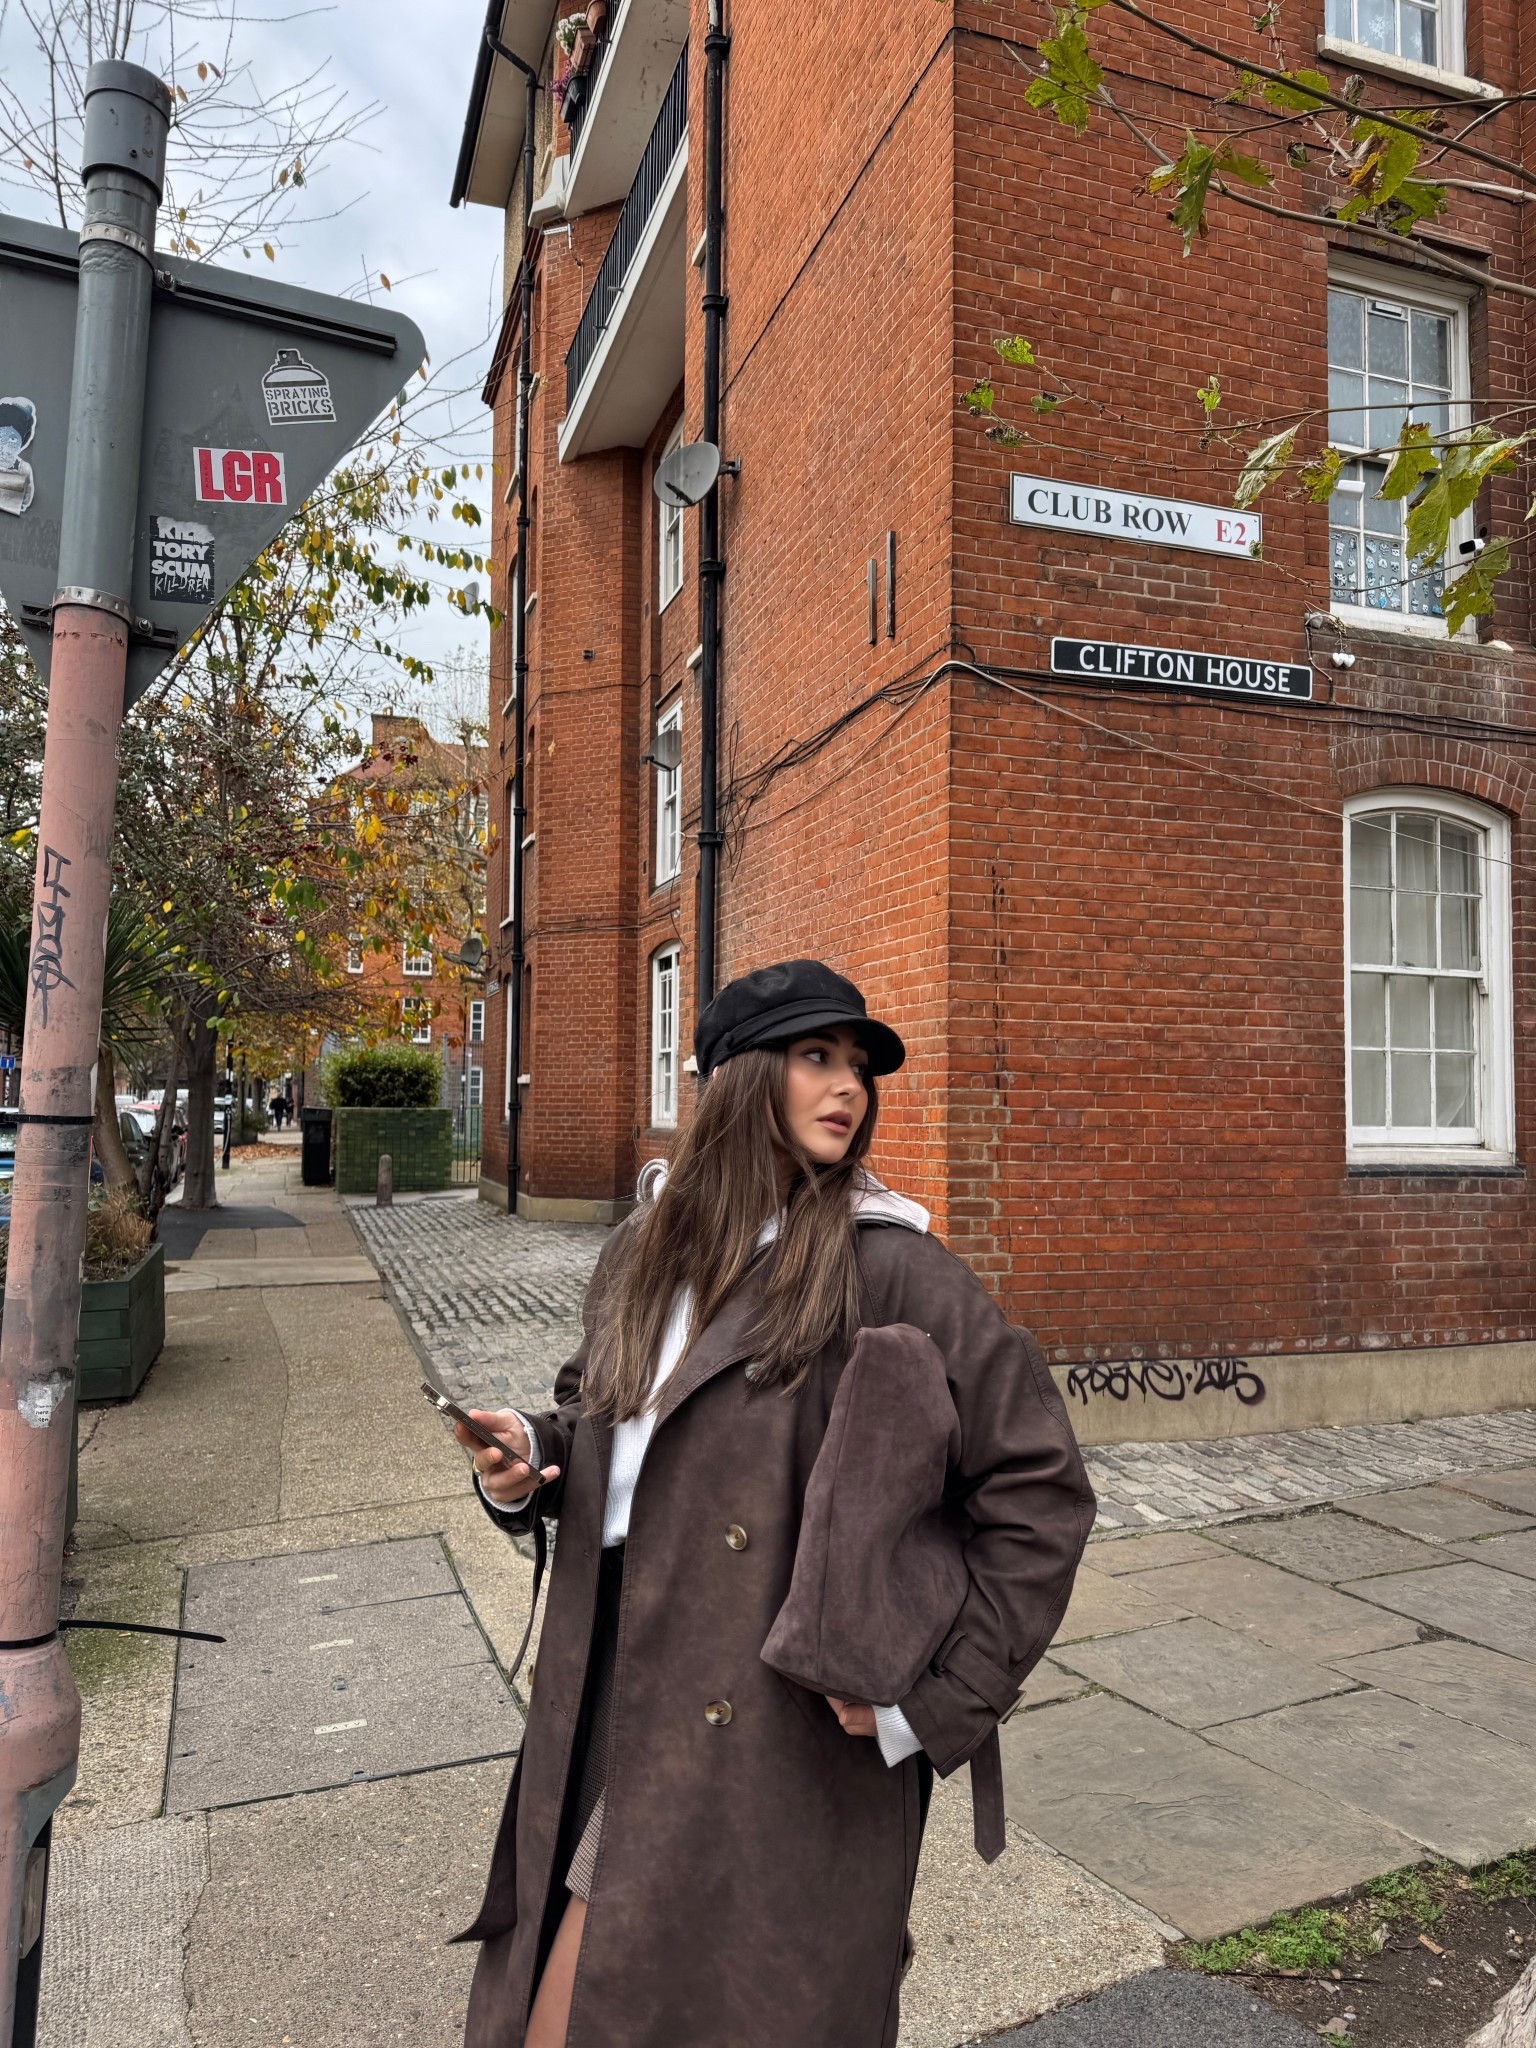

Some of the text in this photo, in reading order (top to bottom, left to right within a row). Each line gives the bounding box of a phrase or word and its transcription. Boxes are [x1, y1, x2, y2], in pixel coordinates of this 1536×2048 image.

[265, 387, 329, 400] SPRAYING
[267, 399, 332, 416] BRICKS
[199, 449, 283, 503] LGR
[1027, 489, 1247, 546] CLUB ROW E2
[153, 541, 209, 560] TORY
[151, 559, 211, 579] SCUM
[1078, 645, 1291, 693] CLIFTON HOUSE
